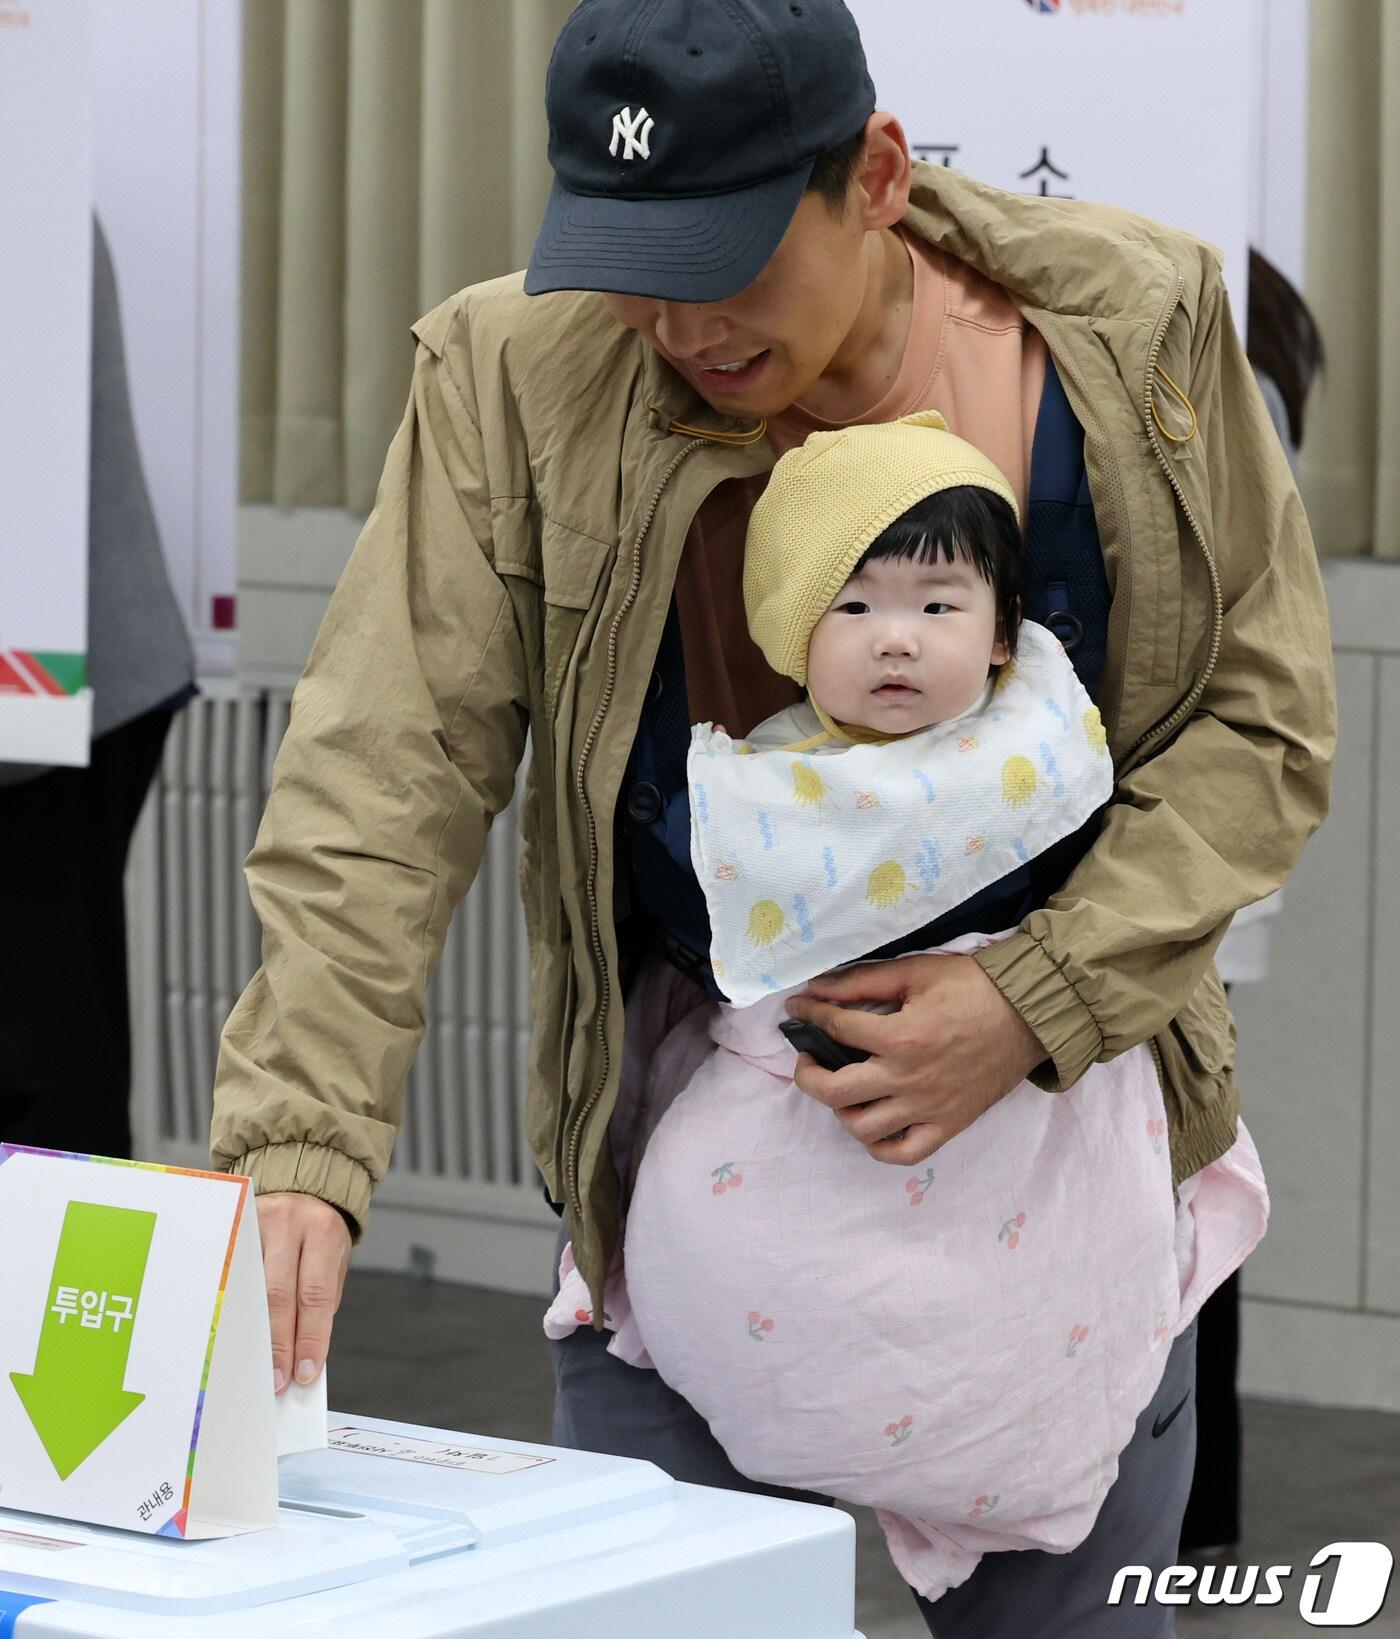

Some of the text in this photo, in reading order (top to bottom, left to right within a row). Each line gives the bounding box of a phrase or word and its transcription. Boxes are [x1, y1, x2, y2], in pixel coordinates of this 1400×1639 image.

[608, 106, 655, 160] NY
[51, 1285, 134, 1333] 투입구
[136, 1481, 175, 1522] 관내용
